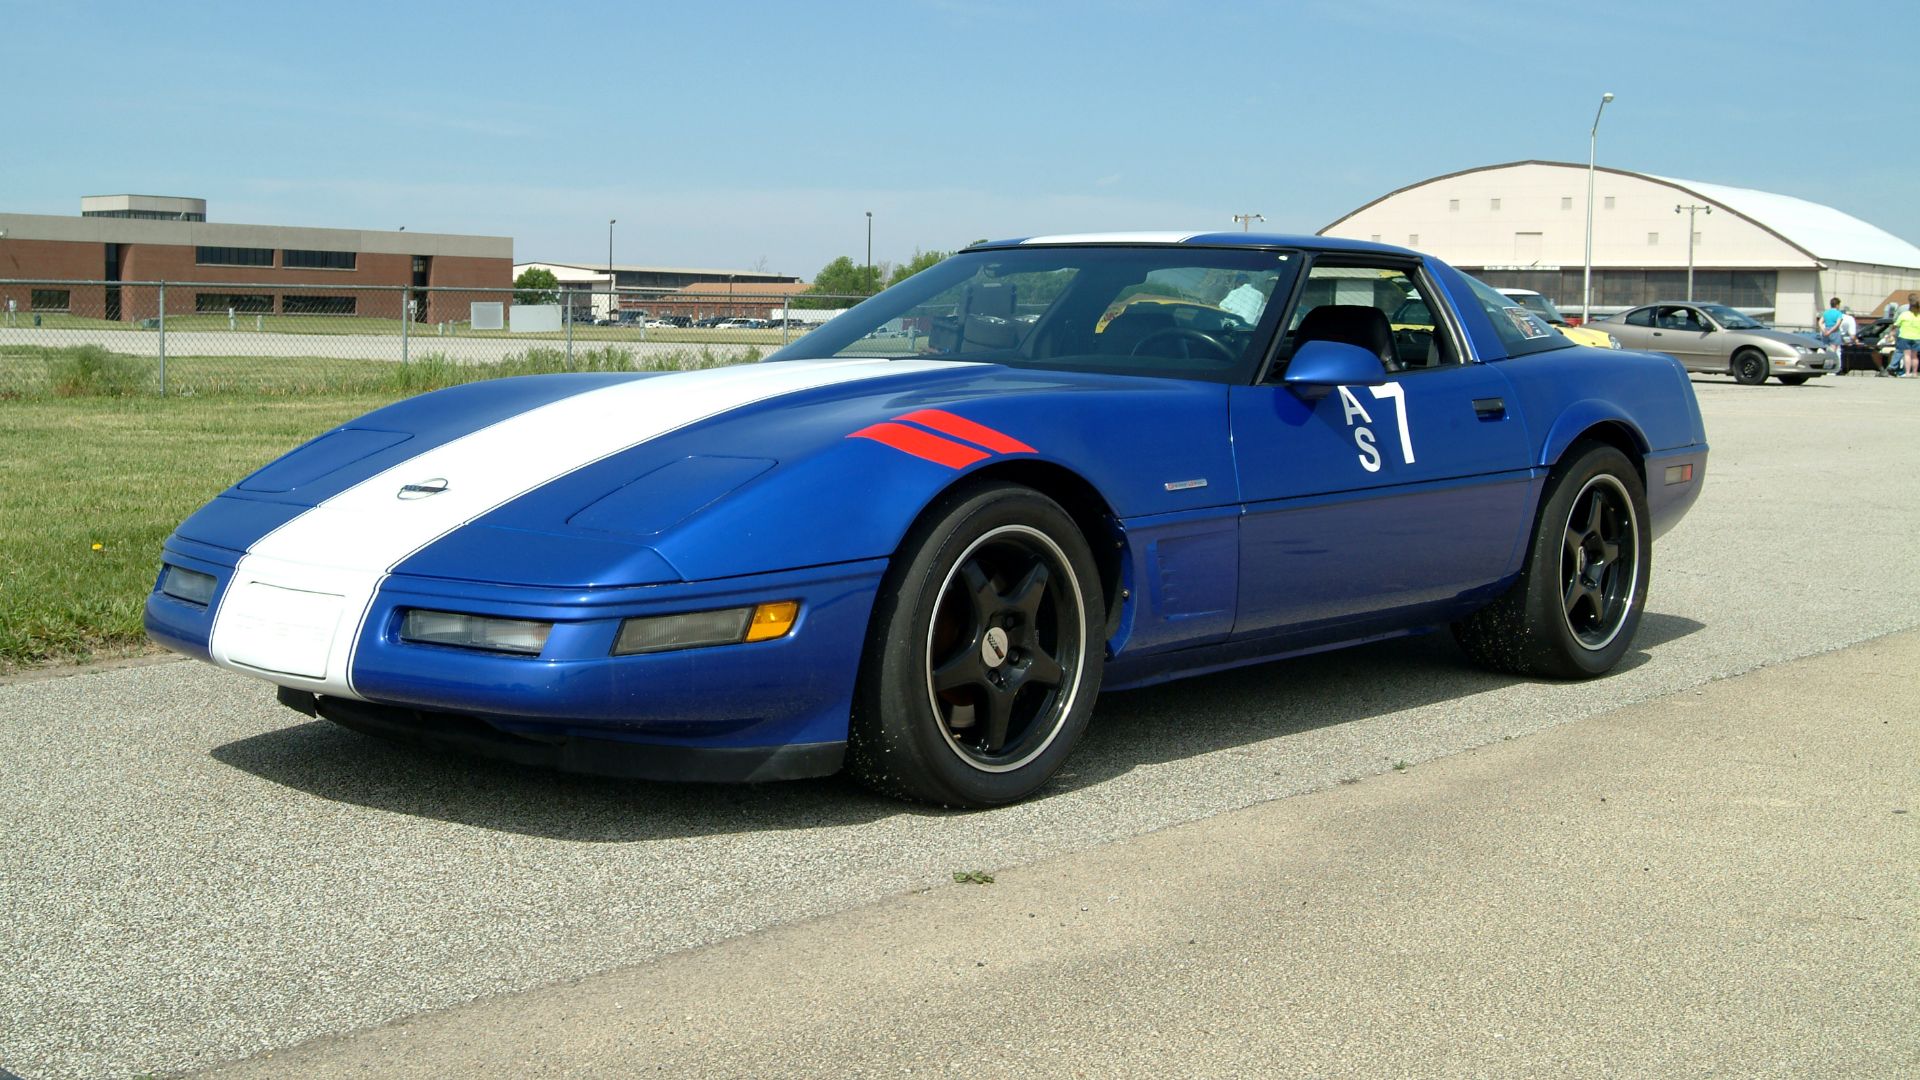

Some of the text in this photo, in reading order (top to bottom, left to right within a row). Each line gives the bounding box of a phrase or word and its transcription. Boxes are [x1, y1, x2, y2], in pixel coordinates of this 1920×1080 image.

[1337, 386, 1372, 425] A
[1368, 382, 1415, 464] 7
[1354, 427, 1381, 472] S
